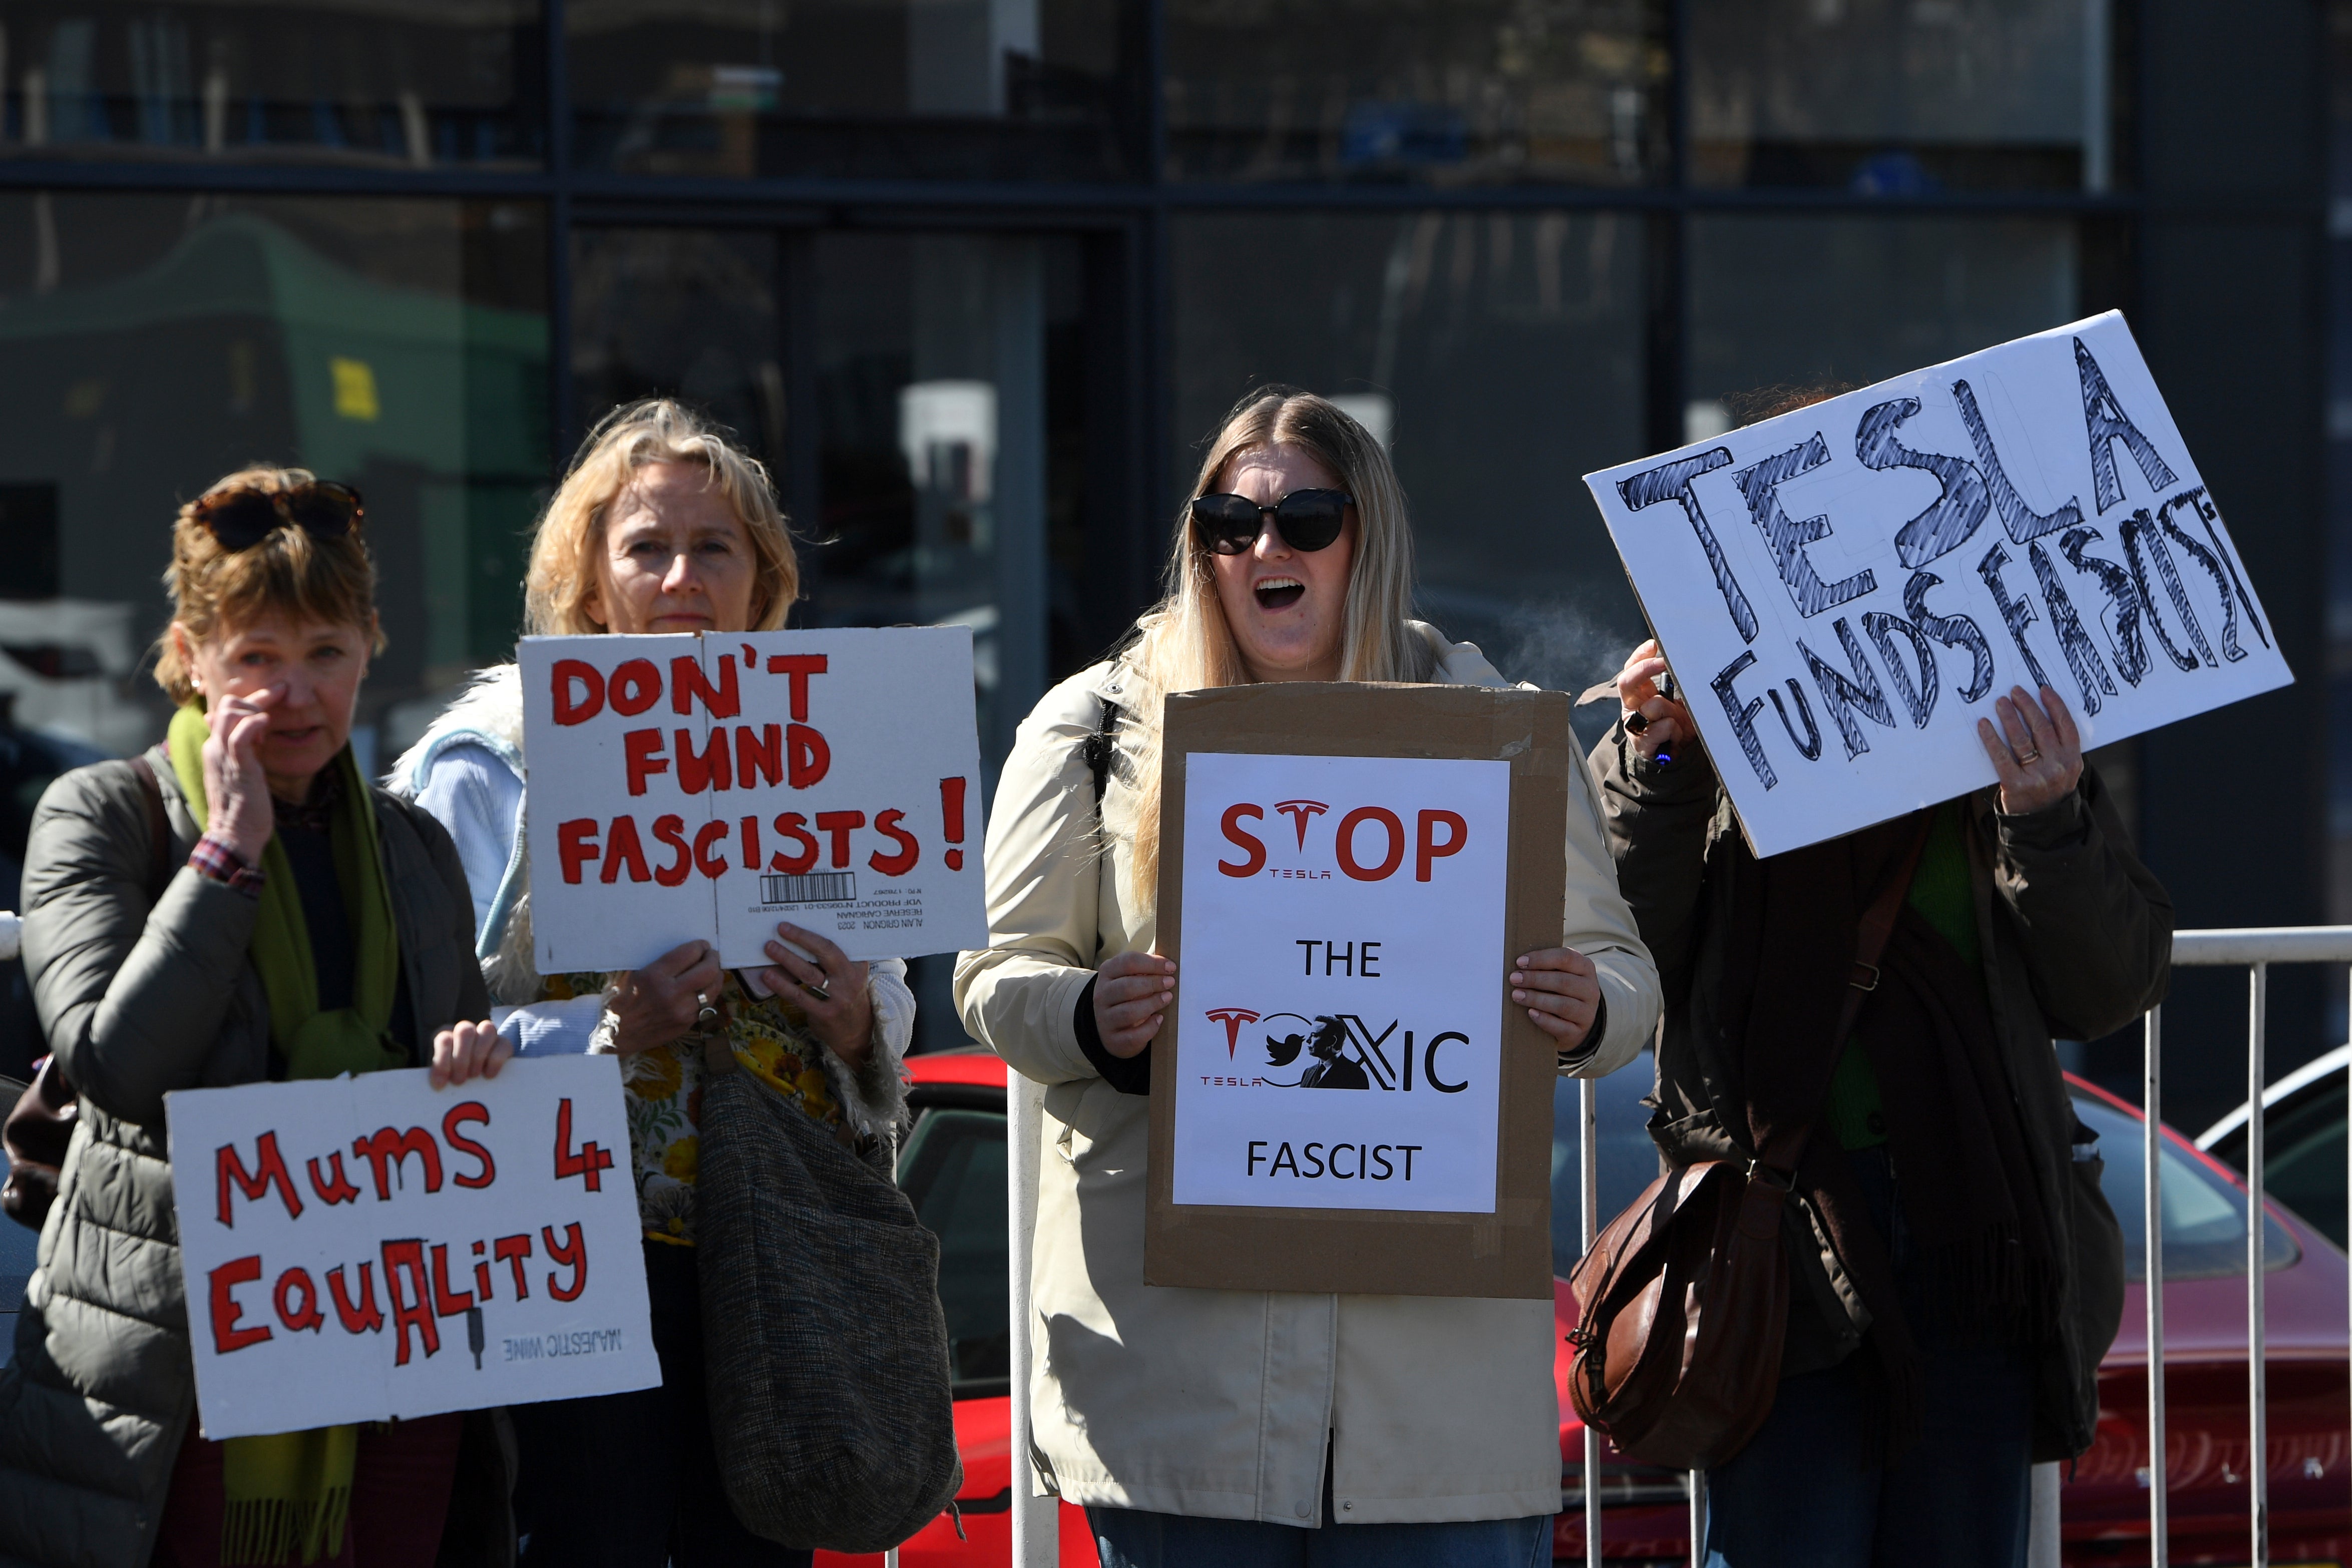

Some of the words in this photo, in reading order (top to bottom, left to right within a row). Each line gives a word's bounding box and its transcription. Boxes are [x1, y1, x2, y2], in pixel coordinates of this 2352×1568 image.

[1616, 336, 2178, 644] TESLA
[551, 643, 828, 726] DON'T
[624, 723, 831, 796] FUND
[1218, 800, 1468, 883] STOP
[1269, 869, 1331, 880] TESLA
[837, 910, 882, 919] CARIGNAN
[838, 921, 856, 930] 2023
[863, 920, 900, 930] GRIGNON
[884, 908, 923, 916] RESERVE
[902, 919, 923, 928] ALAIN
[1296, 940, 1381, 977] THE
[1200, 1076, 1262, 1087] TESLA
[554, 1098, 615, 1193] 4
[1247, 1141, 1423, 1182] FASCIST
[503, 1336, 545, 1362] WINE
[546, 1328, 621, 1358] MAJESTIC
